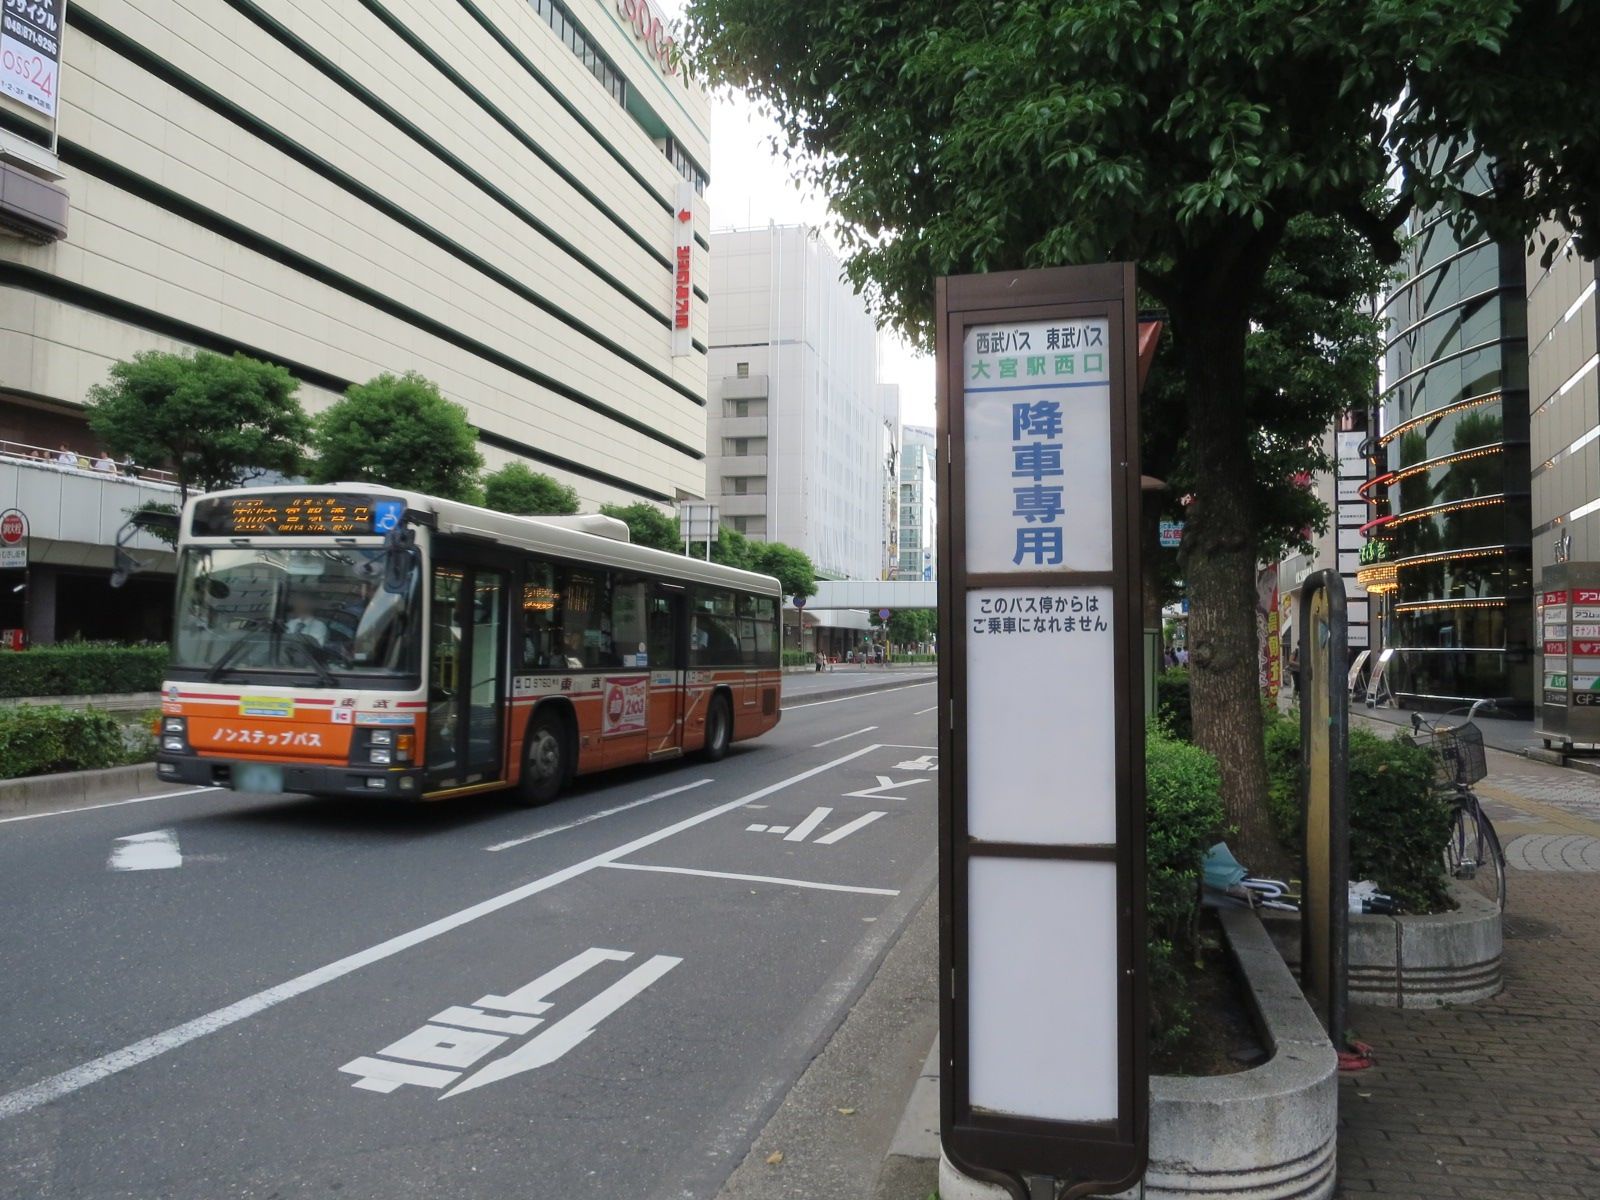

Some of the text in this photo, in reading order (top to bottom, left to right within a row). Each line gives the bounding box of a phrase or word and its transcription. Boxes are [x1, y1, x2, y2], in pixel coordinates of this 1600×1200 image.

[976, 326, 1103, 354] 西武バス 東武バス
[971, 353, 1103, 380] 大宮駅西口
[1011, 400, 1065, 566] 降車専用
[980, 595, 1099, 614] このバス停からは
[1579, 592, 1600, 601] アコ
[973, 615, 1108, 634] ご乗車になれません
[212, 728, 322, 747] ノンステップバス
